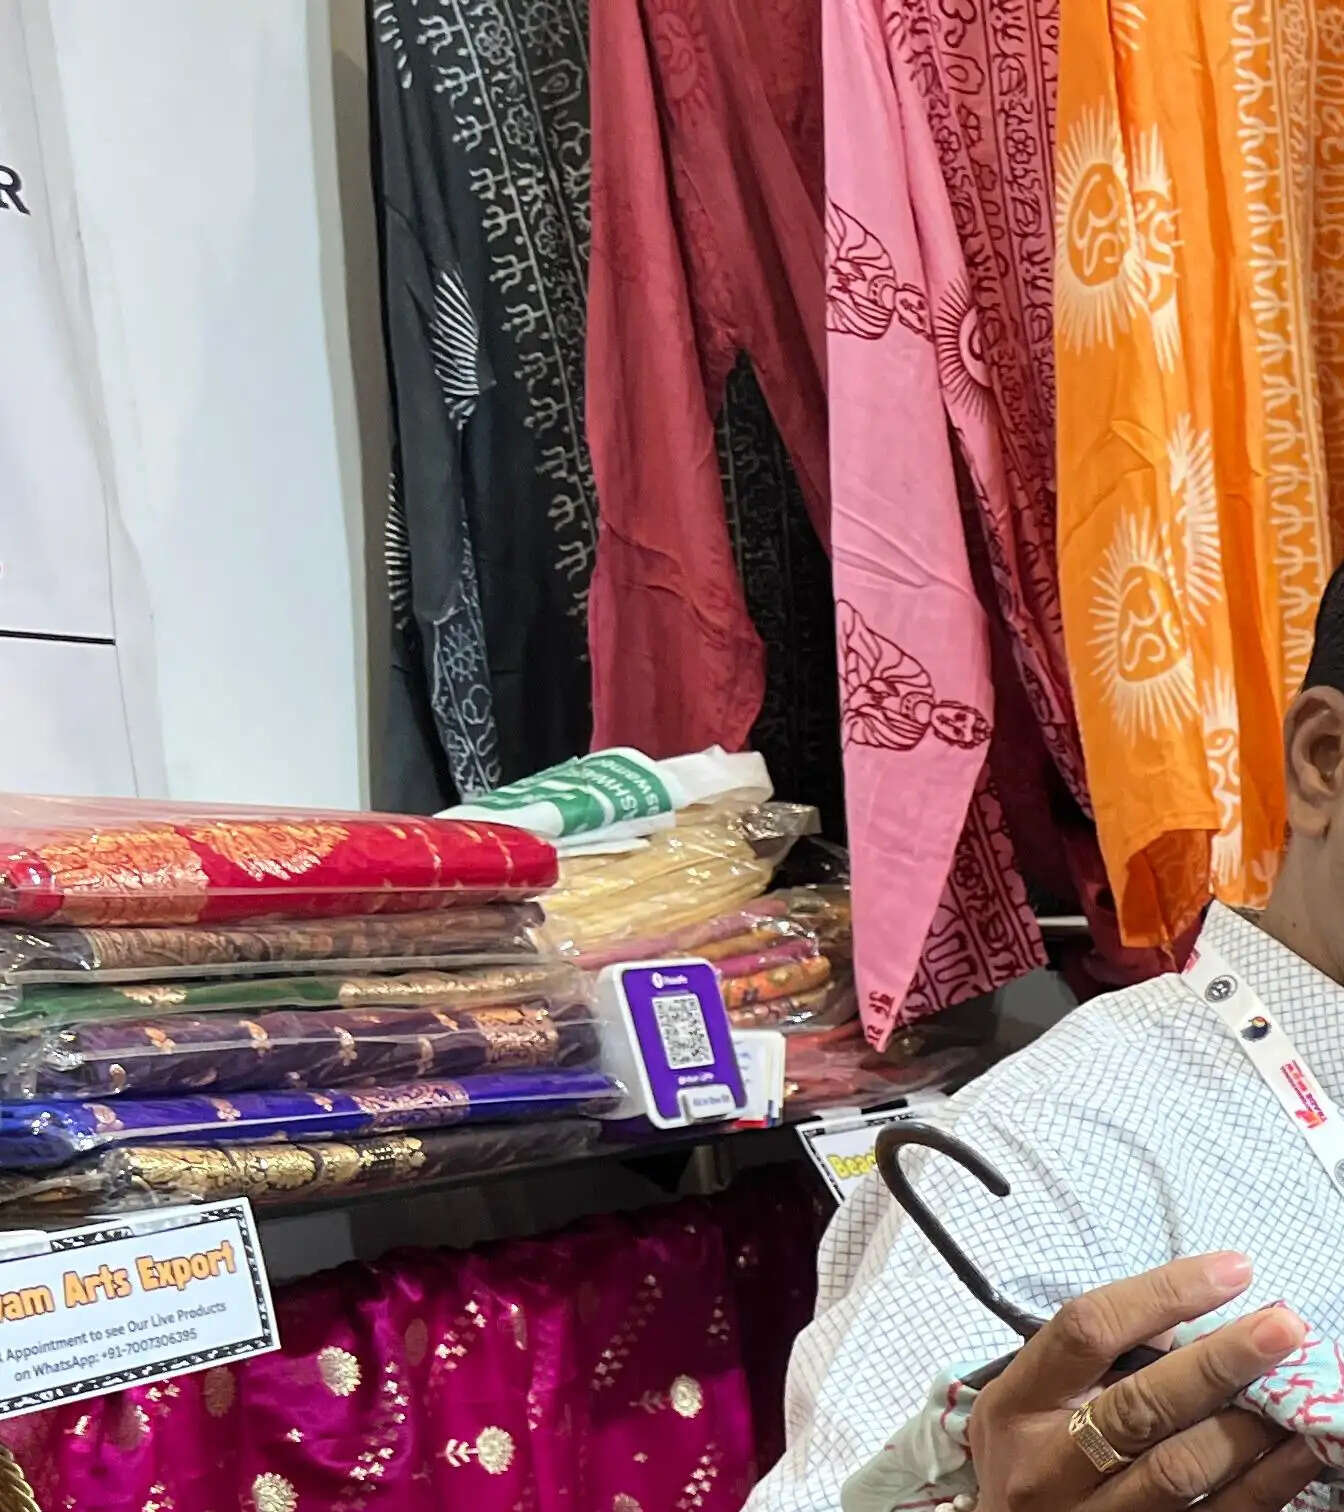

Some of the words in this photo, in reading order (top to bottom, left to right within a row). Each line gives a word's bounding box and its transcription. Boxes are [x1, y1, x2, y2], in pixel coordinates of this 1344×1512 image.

[63, 1264, 131, 1308] Arts
[135, 1240, 236, 1291] Export
[6, 1333, 88, 1362] Appointment
[89, 1331, 102, 1342] to
[105, 1326, 125, 1338] see
[128, 1319, 148, 1332] Our
[150, 1314, 175, 1327] Live
[177, 1303, 226, 1321] Products
[14, 1370, 31, 1381] on
